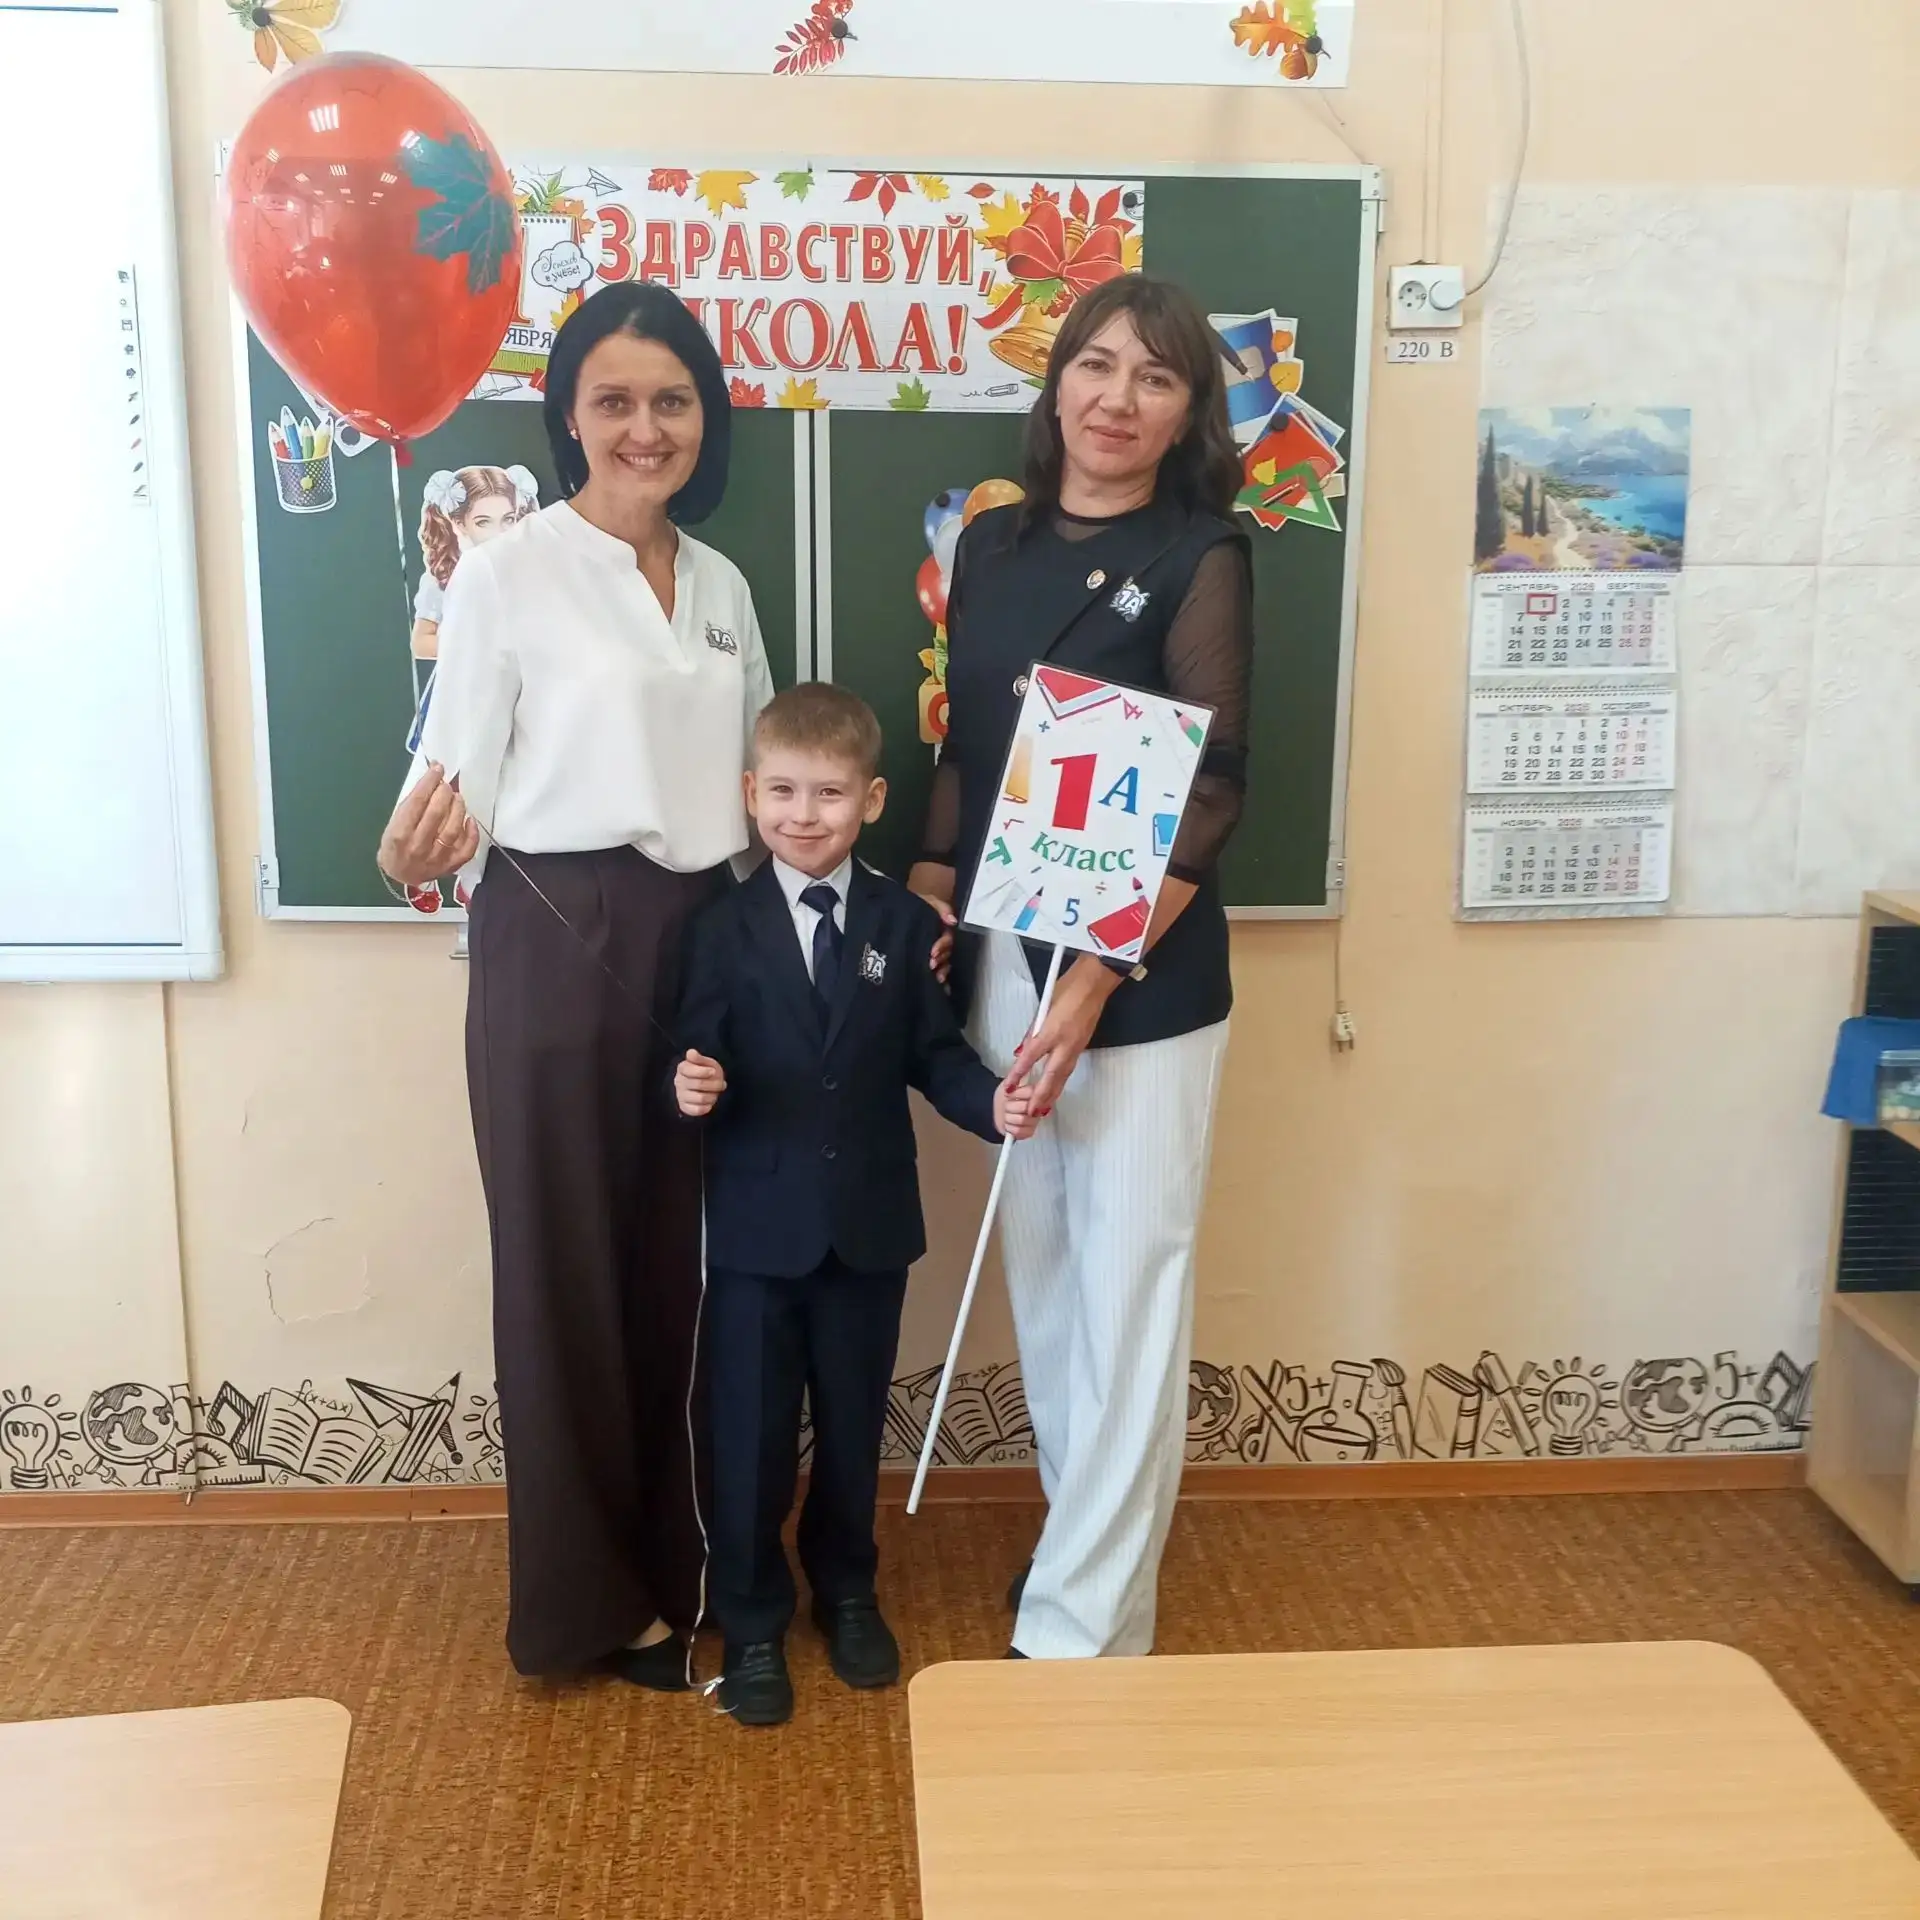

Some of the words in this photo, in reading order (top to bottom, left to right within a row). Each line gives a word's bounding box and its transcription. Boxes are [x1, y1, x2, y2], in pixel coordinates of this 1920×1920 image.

[595, 204, 996, 296] ЗДРАВСТВУЙ,
[505, 327, 553, 349] ЯБРЯ
[681, 297, 968, 376] КОЛА!
[1398, 341, 1430, 358] 220
[1440, 341, 1453, 358] В
[1541, 600, 1547, 608] 1
[1562, 599, 1570, 608] 2
[1584, 599, 1592, 608] 3
[1607, 599, 1614, 608] 4
[1517, 612, 1525, 621] 7
[1562, 612, 1569, 621] 9
[1578, 612, 1591, 621] 10
[1601, 612, 1612, 621] 11
[1510, 626, 1524, 635] 14
[1533, 626, 1547, 635] 15
[1578, 626, 1591, 635] 17
[1600, 625, 1613, 634] 18
[1508, 640, 1521, 649] 21
[1530, 639, 1545, 648] 22
[1553, 639, 1568, 648] 23
[1575, 639, 1590, 648] 24
[1598, 638, 1612, 648] 25
[1507, 653, 1522, 662] 28
[1530, 653, 1545, 662] 29
[1552, 653, 1568, 661] 30
[1601, 718, 1609, 727] 2
[1640, 717, 1648, 726] 4
[1511, 733, 1519, 742] 5
[1533, 732, 1542, 742] 6
[1556, 732, 1564, 741] 7
[1578, 732, 1586, 741] 8
[1616, 731, 1629, 740] 10
[1505, 746, 1518, 755] 12
[1528, 746, 1541, 755] 13
[1550, 745, 1563, 754] 14
[1572, 745, 1585, 754] 15
[1594, 744, 1607, 753] 16
[1615, 744, 1627, 753] 17
[1504, 759, 1518, 768] 19
[1525, 759, 1540, 768] 20
[1548, 759, 1562, 767] 21
[1569, 758, 1584, 767] 22
[1592, 758, 1606, 767] 23
[1612, 757, 1626, 766] 24
[1632, 756, 1645, 765] 25
[1502, 772, 1516, 781] 26
[1524, 772, 1540, 780] 27
[1569, 771, 1584, 780] 29
[1591, 770, 1605, 779] 30
[1030, 832, 1136, 873] класс
[1506, 847, 1513, 856] 2
[1527, 847, 1536, 855] 3
[1571, 845, 1579, 854] 5
[1522, 860, 1535, 868] 10
[1544, 860, 1555, 868] 11
[1564, 859, 1579, 868] 12
[1586, 858, 1600, 867] 13
[1521, 872, 1534, 881] 17
[1564, 872, 1576, 880] 19
[1584, 871, 1599, 880] 20
[1624, 869, 1639, 878] 22
[1518, 885, 1533, 894] 24
[1540, 884, 1555, 893] 25
[1584, 883, 1599, 892] 27
[1063, 898, 1080, 927] 5
